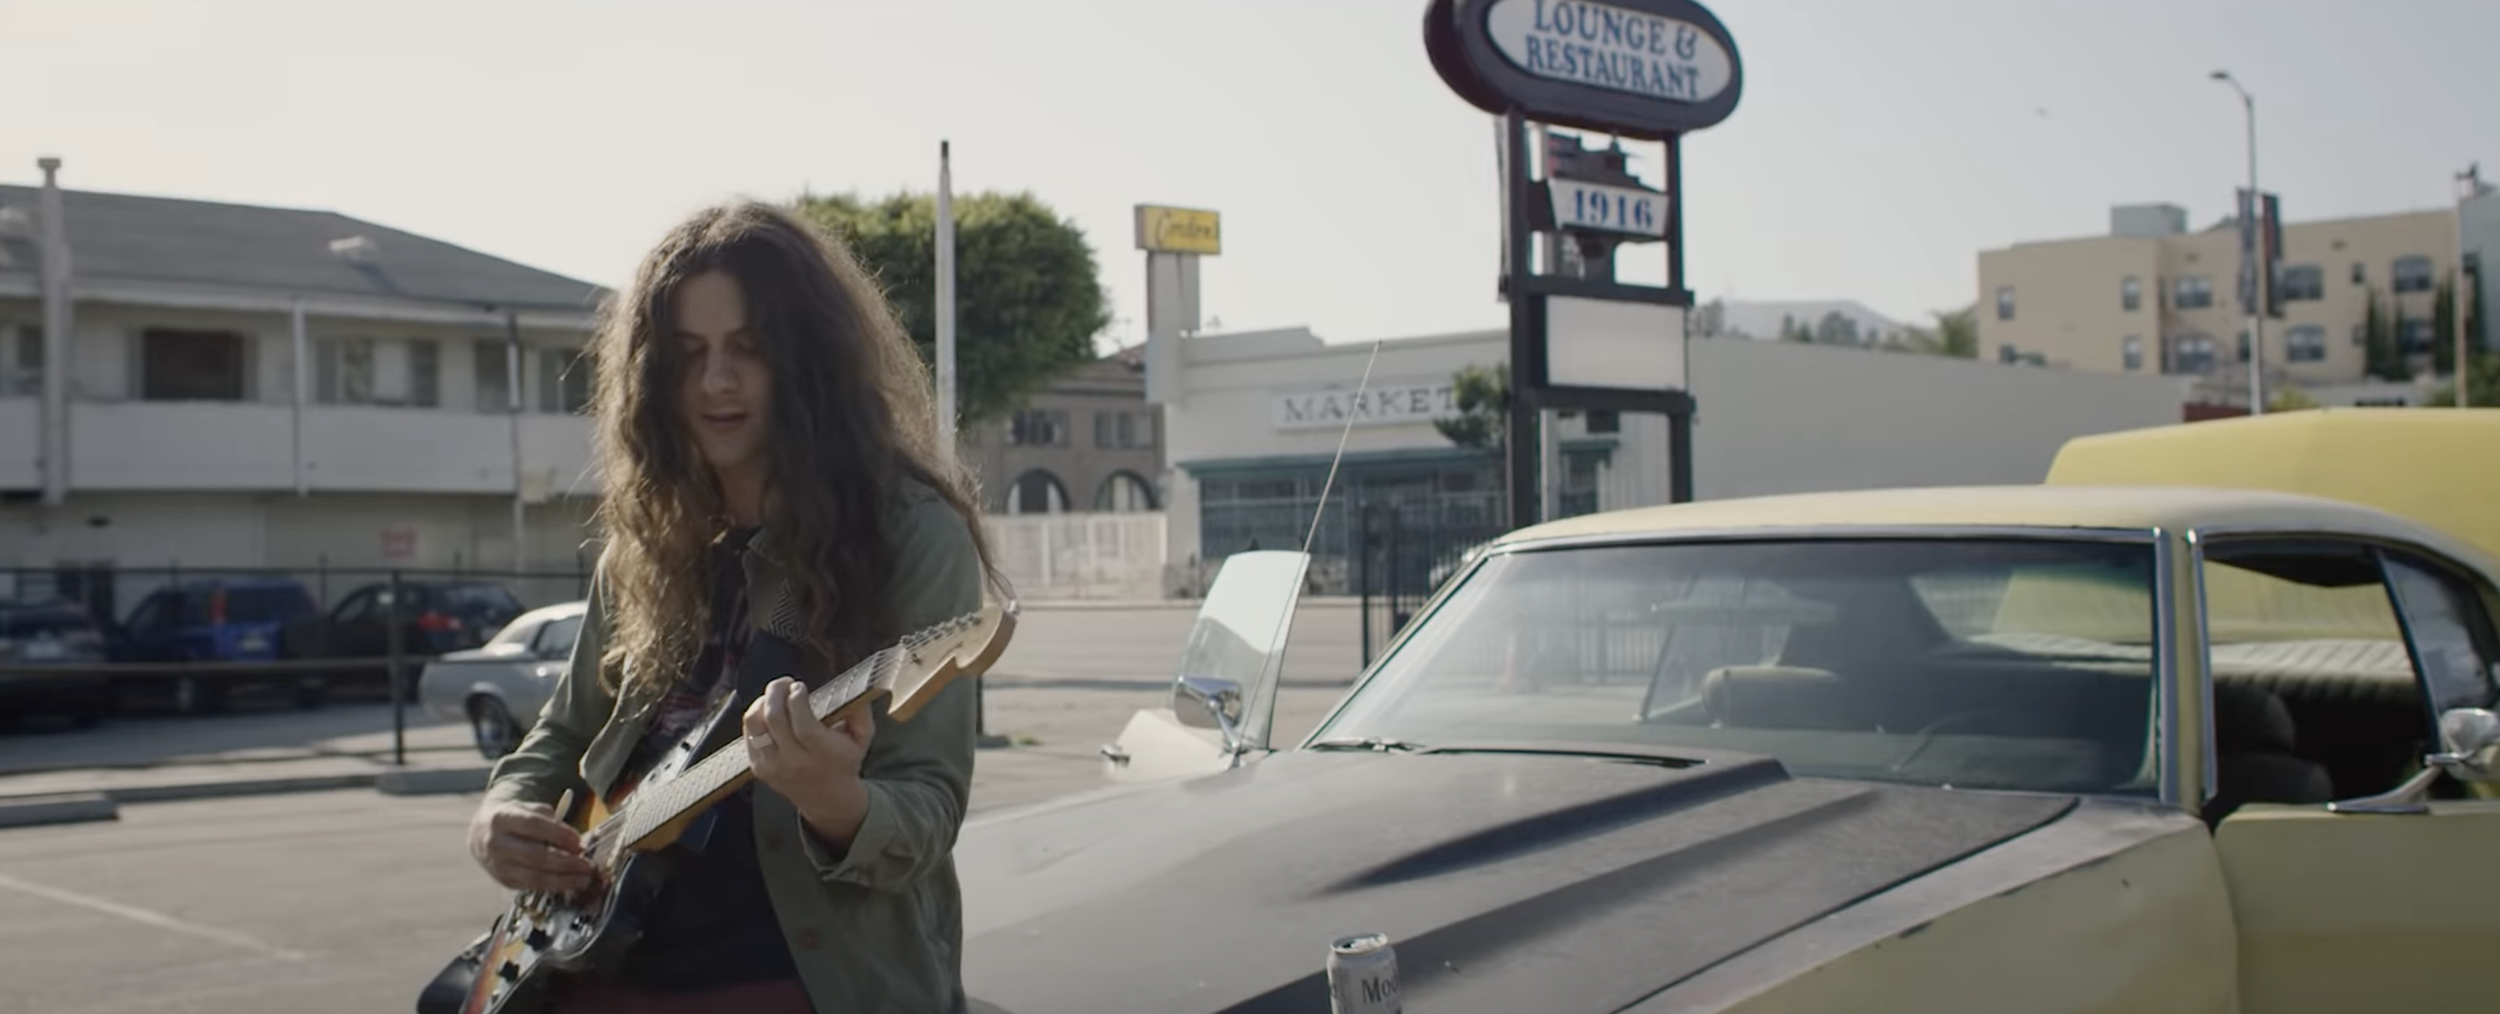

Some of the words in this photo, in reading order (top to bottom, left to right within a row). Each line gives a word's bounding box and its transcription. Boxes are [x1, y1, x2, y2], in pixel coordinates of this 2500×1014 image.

[1534, 0, 1667, 56] LOUNGE
[1673, 25, 1699, 60] &
[1526, 34, 1700, 97] RESTAURANT
[1572, 188, 1654, 230] 1916
[1284, 384, 1456, 423] MARKET
